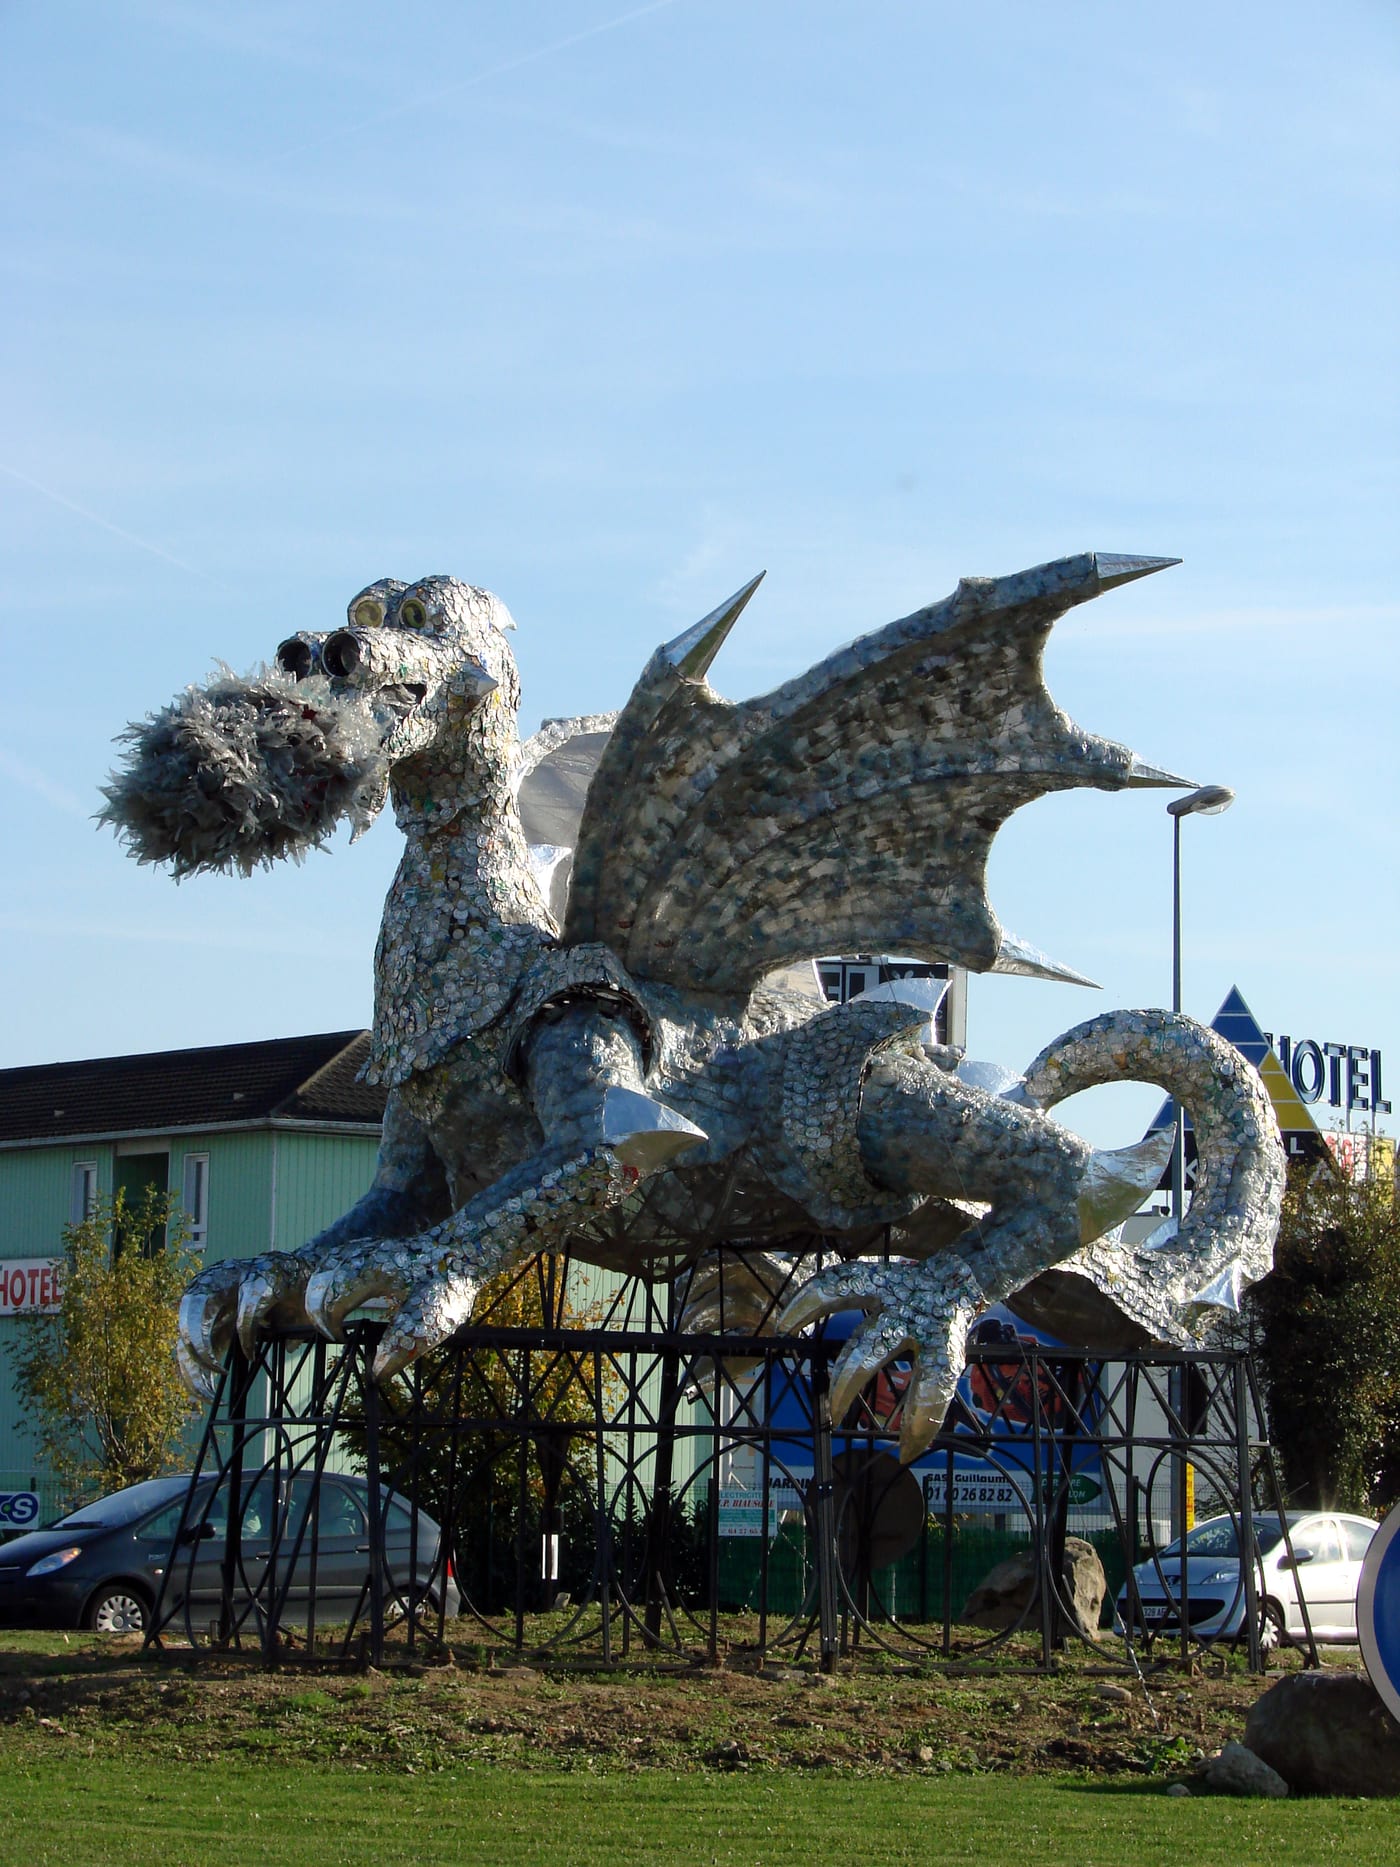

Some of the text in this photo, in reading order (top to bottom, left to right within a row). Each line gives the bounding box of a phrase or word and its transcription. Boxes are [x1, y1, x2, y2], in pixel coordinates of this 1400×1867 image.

[961, 1488, 977, 1501] 26
[979, 1488, 995, 1502] 82
[997, 1488, 1013, 1502] 82
